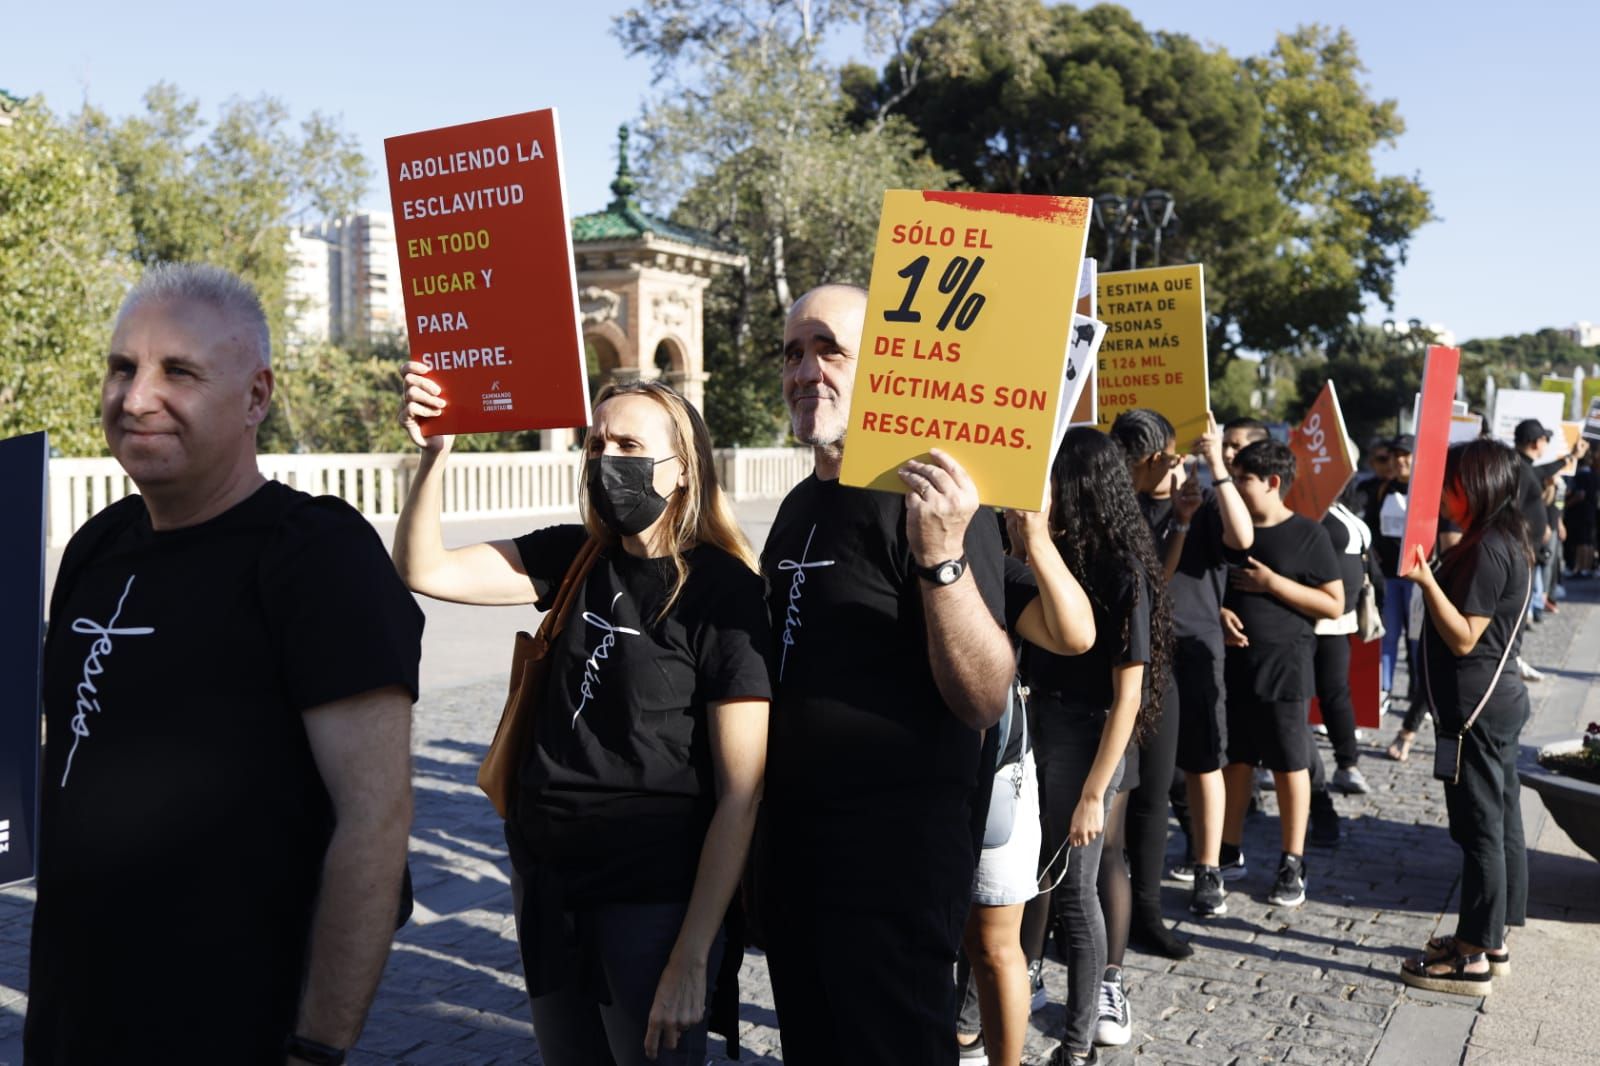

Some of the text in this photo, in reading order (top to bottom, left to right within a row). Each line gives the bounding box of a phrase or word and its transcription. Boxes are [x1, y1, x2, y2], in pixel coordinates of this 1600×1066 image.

[400, 139, 544, 182] ABOLIENDO LA
[403, 184, 524, 220] ESCLAVITUD
[407, 229, 490, 258] EN TODO
[891, 220, 993, 249] SÓLO EL
[412, 269, 493, 297] LUGAR Y
[883, 255, 986, 332] 1%
[1107, 280, 1159, 296] ESTIMA
[1164, 278, 1193, 291] QUE
[1108, 300, 1152, 315] TRATA
[1157, 298, 1176, 311] DE
[417, 311, 468, 335] PARA
[1106, 319, 1162, 332] RSONAS
[873, 336, 961, 363] DE LAS
[1099, 335, 1180, 352] ENERA MÁS
[422, 346, 513, 372] SIEMPRE.
[1112, 359, 1136, 369] 126
[1141, 356, 1166, 367] MIL
[869, 370, 1047, 411] VÍCTIMAS SON
[1097, 372, 1184, 388] ILLONES DE
[1100, 394, 1137, 407] UROS
[862, 411, 1032, 450] RESCATADAS.
[1303, 413, 1332, 474] 99%
